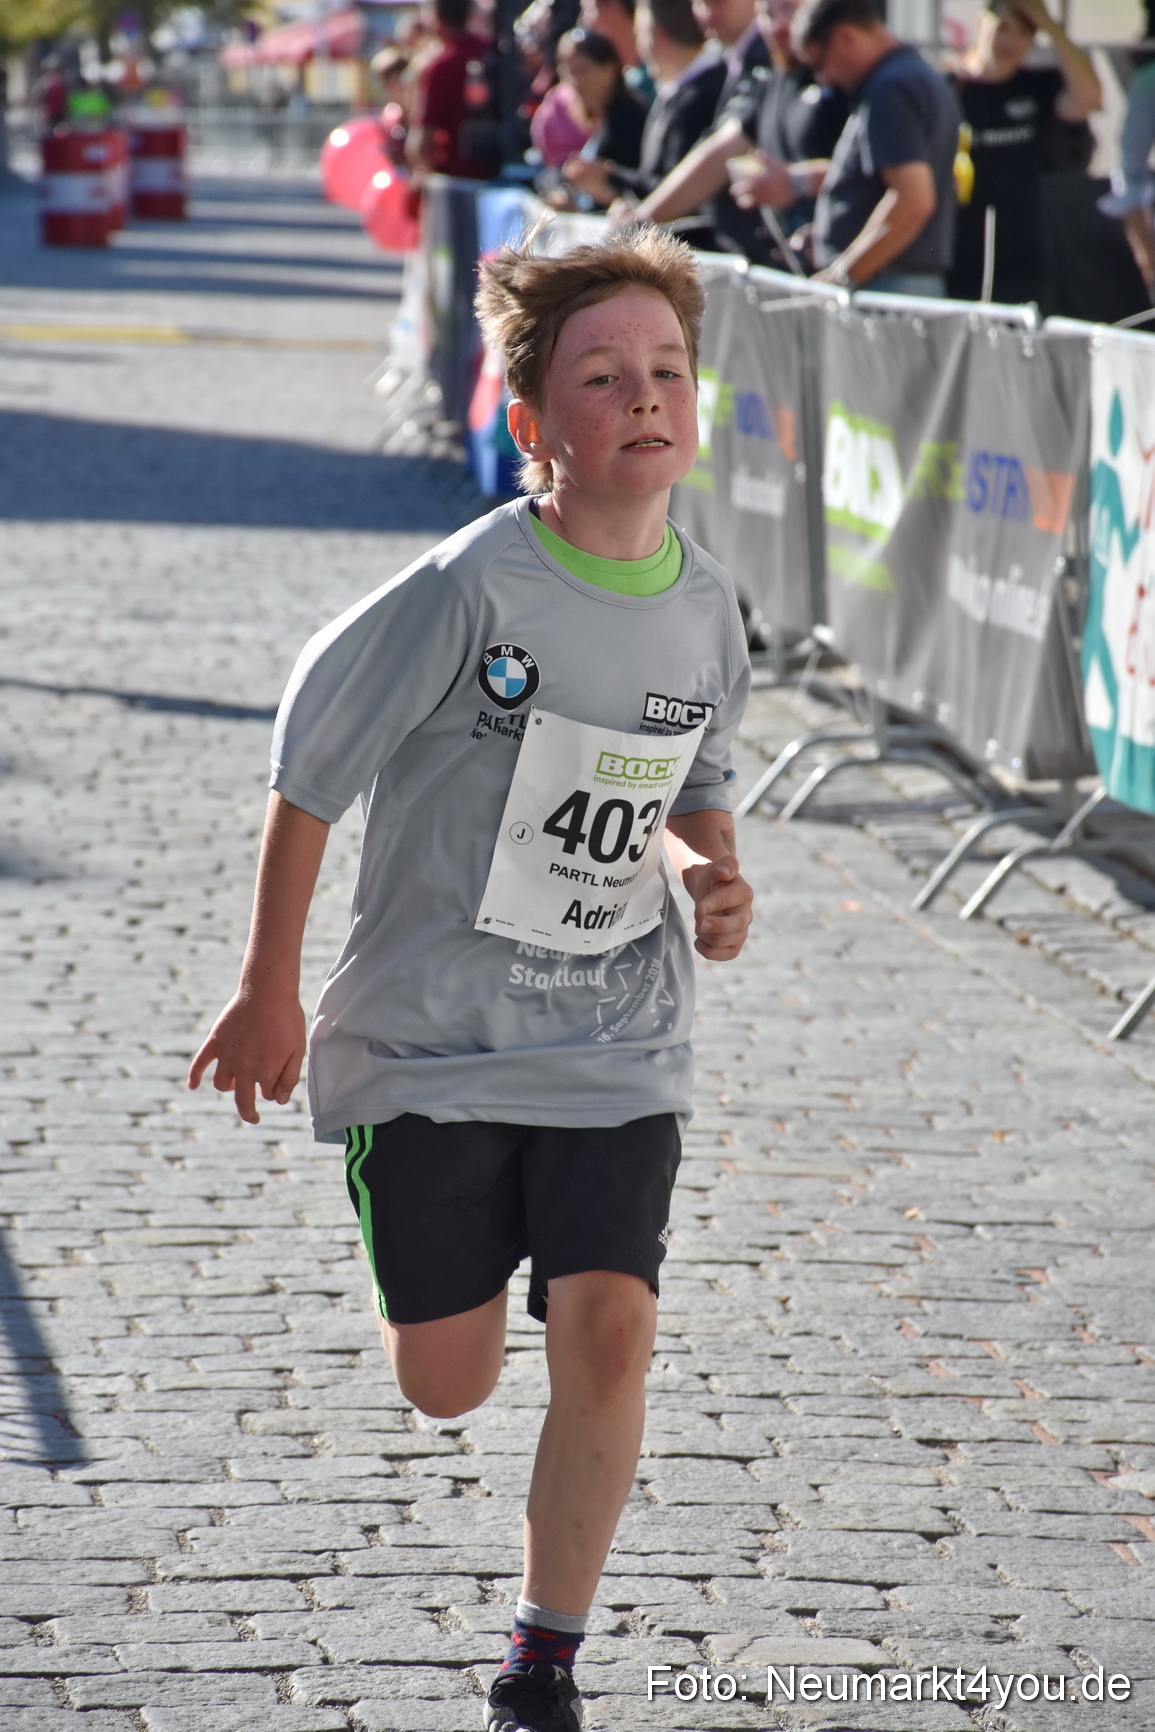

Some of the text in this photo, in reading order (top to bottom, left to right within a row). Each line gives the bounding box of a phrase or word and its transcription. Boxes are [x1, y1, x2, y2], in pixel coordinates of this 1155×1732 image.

[483, 646, 535, 669] BMW
[639, 722, 665, 735] inspired
[593, 774, 626, 788] inspired
[627, 781, 637, 790] by
[516, 828, 526, 840] J
[542, 789, 663, 864] 403
[549, 862, 599, 887] PARTL
[597, 958, 663, 1044] 16. September 2018
